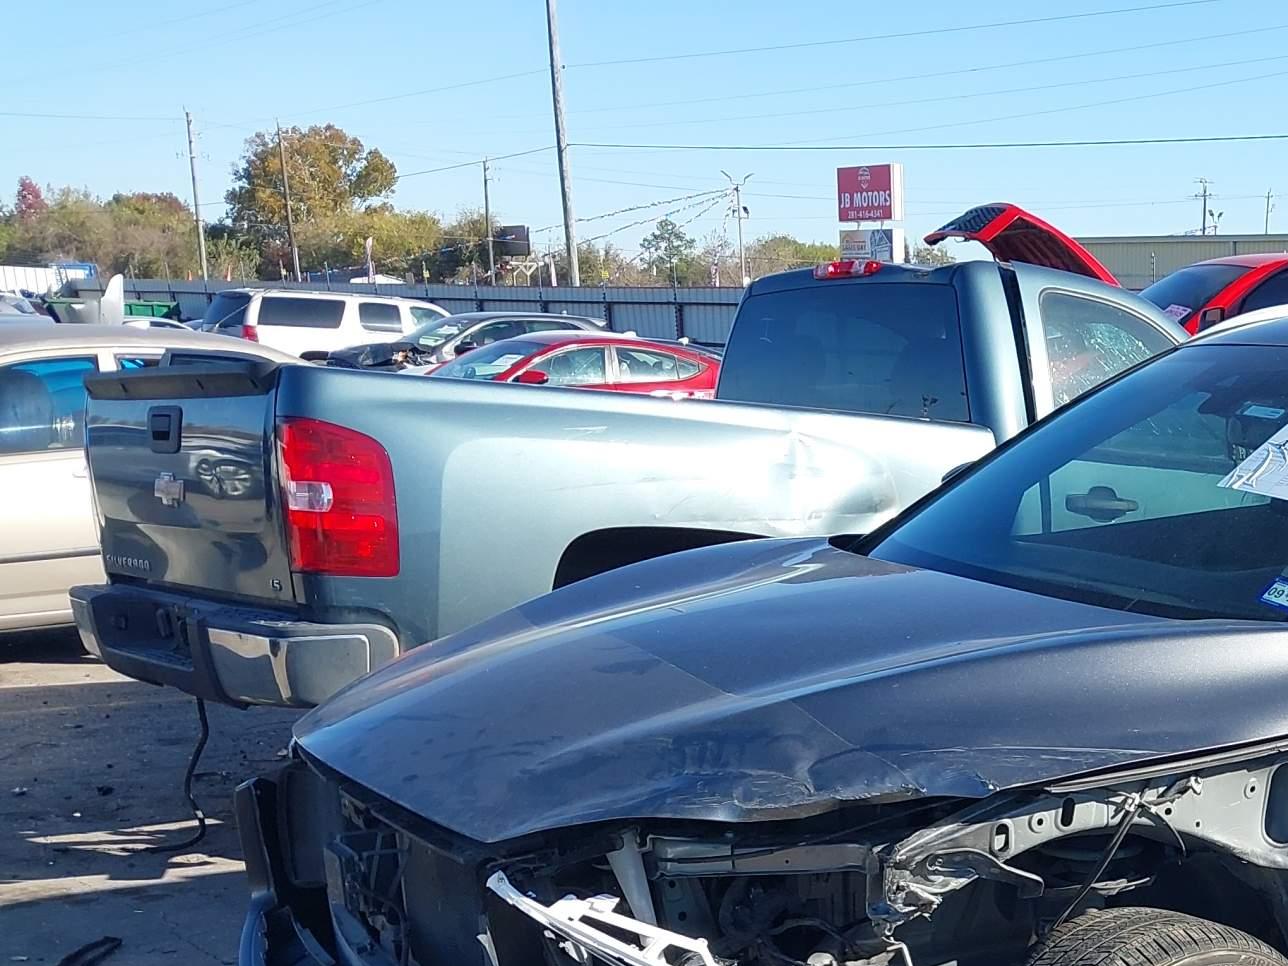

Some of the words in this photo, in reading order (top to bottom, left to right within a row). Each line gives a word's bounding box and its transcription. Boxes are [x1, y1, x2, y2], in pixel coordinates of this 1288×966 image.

[840, 192, 851, 209] JB
[853, 190, 890, 208] MOTORS
[106, 554, 150, 570] SILVERADO
[1267, 587, 1286, 599] 09
